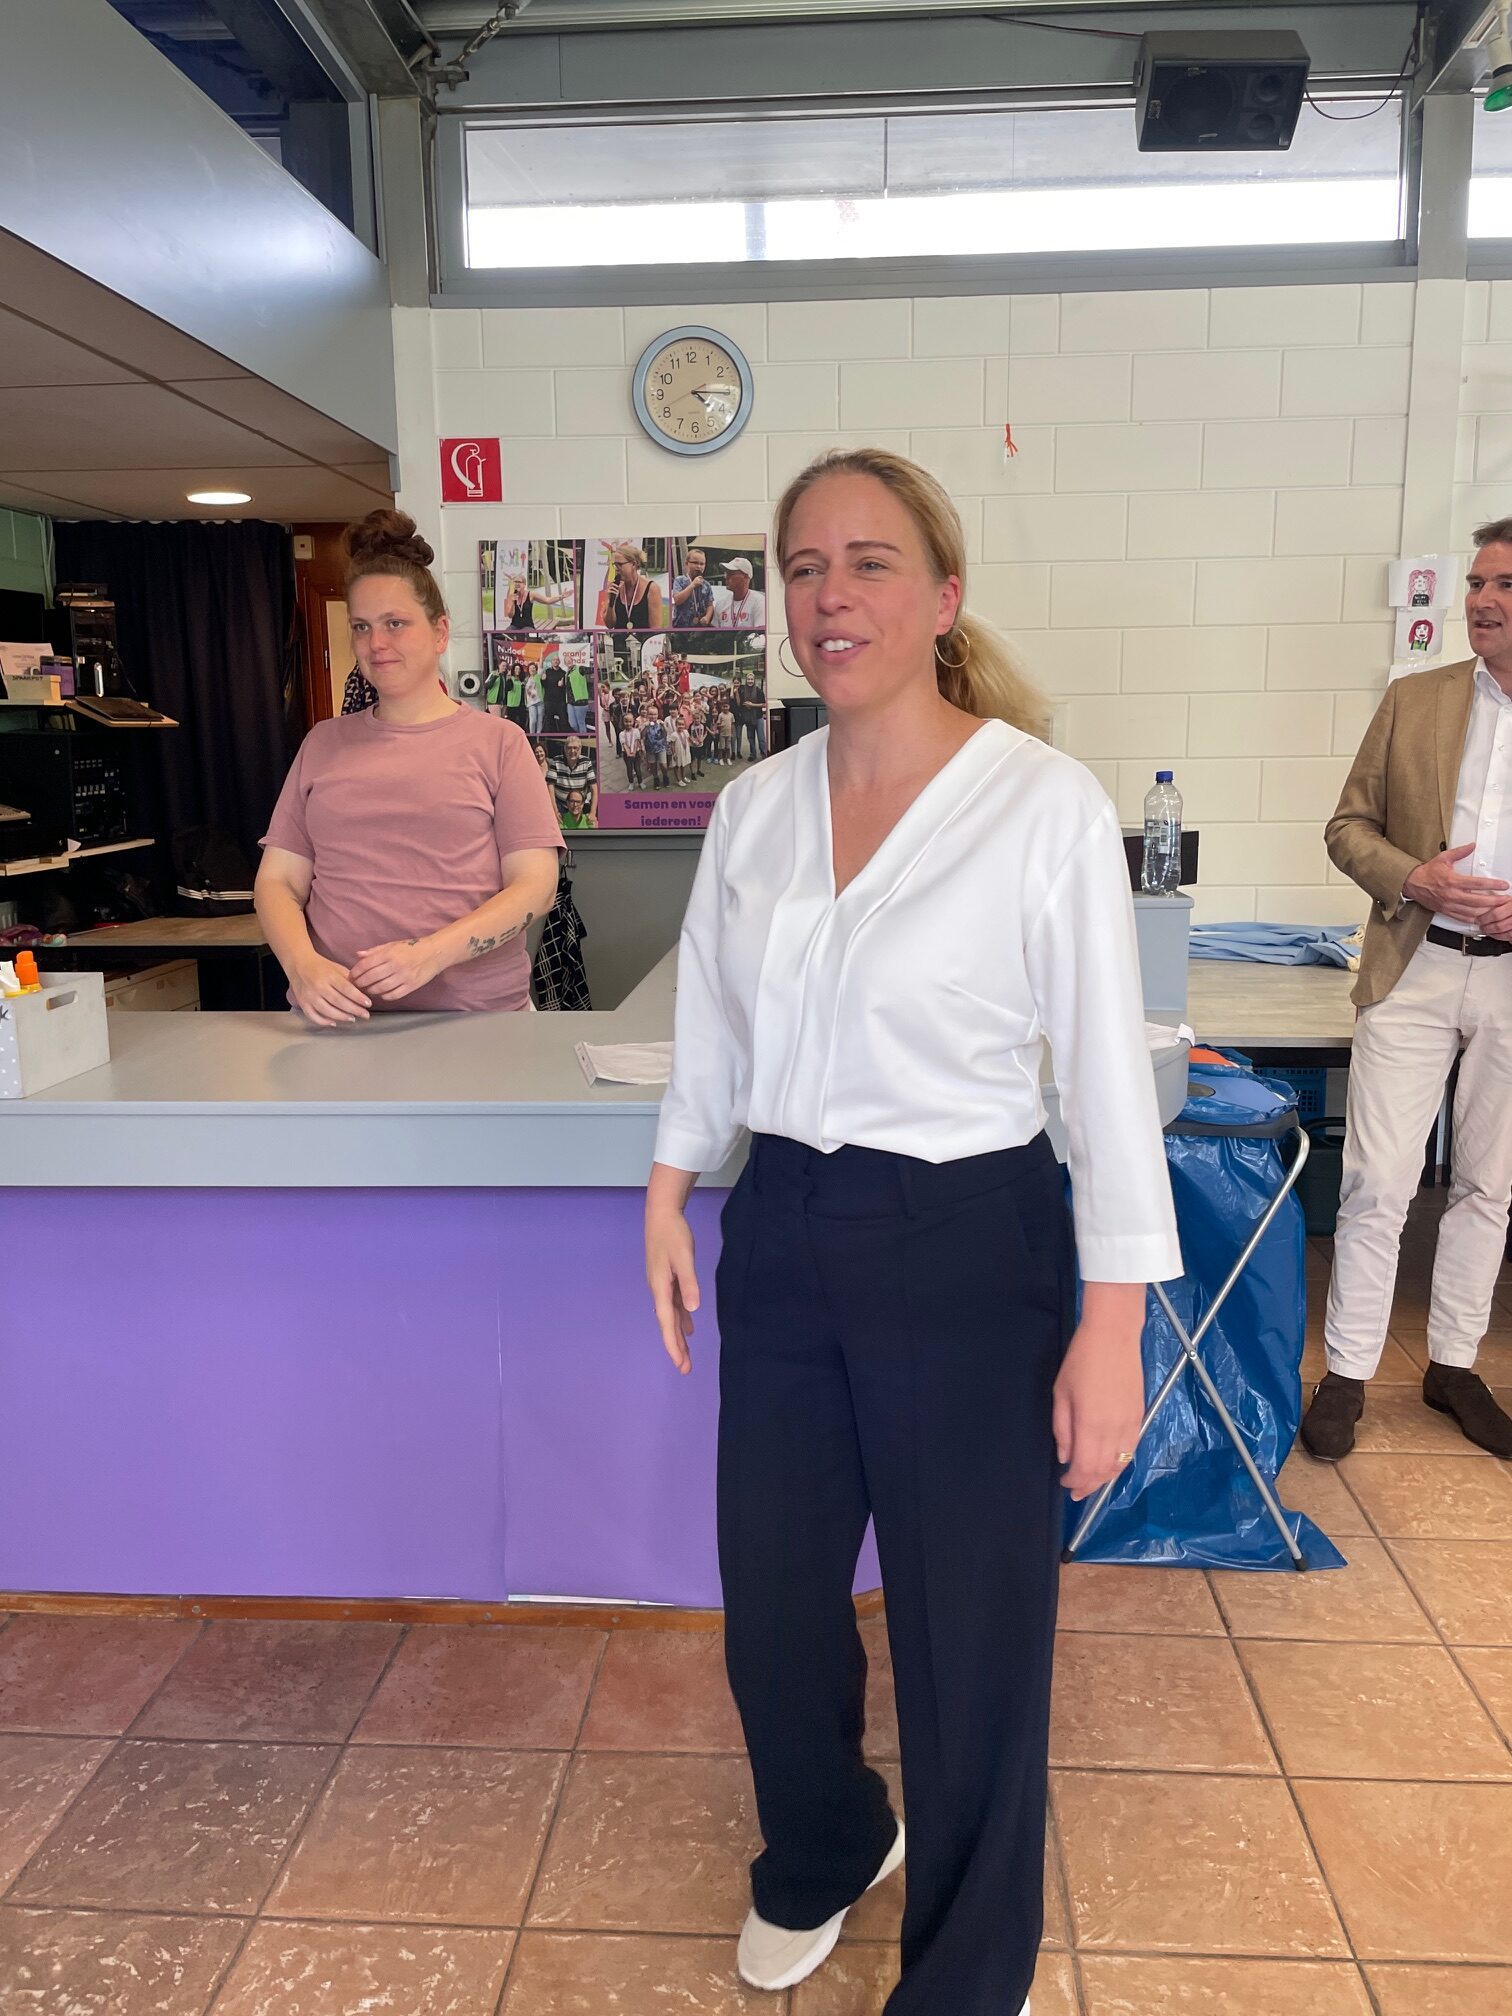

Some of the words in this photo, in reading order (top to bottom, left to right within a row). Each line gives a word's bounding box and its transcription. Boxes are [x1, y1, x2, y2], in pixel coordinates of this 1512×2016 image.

[686, 351, 697, 364] 12
[705, 355, 711, 366] 1
[670, 358, 680, 370] 11
[716, 366, 724, 378] 2
[660, 373, 673, 385] 10
[656, 389, 664, 400] 9
[663, 406, 671, 418] 8
[718, 403, 725, 414] 4
[677, 418, 684, 430] 7
[707, 416, 715, 427] 5
[691, 422, 699, 434] 6
[624, 800, 669, 809] Samen
[671, 800, 686, 809] en
[641, 815, 701, 826] iedereen!
